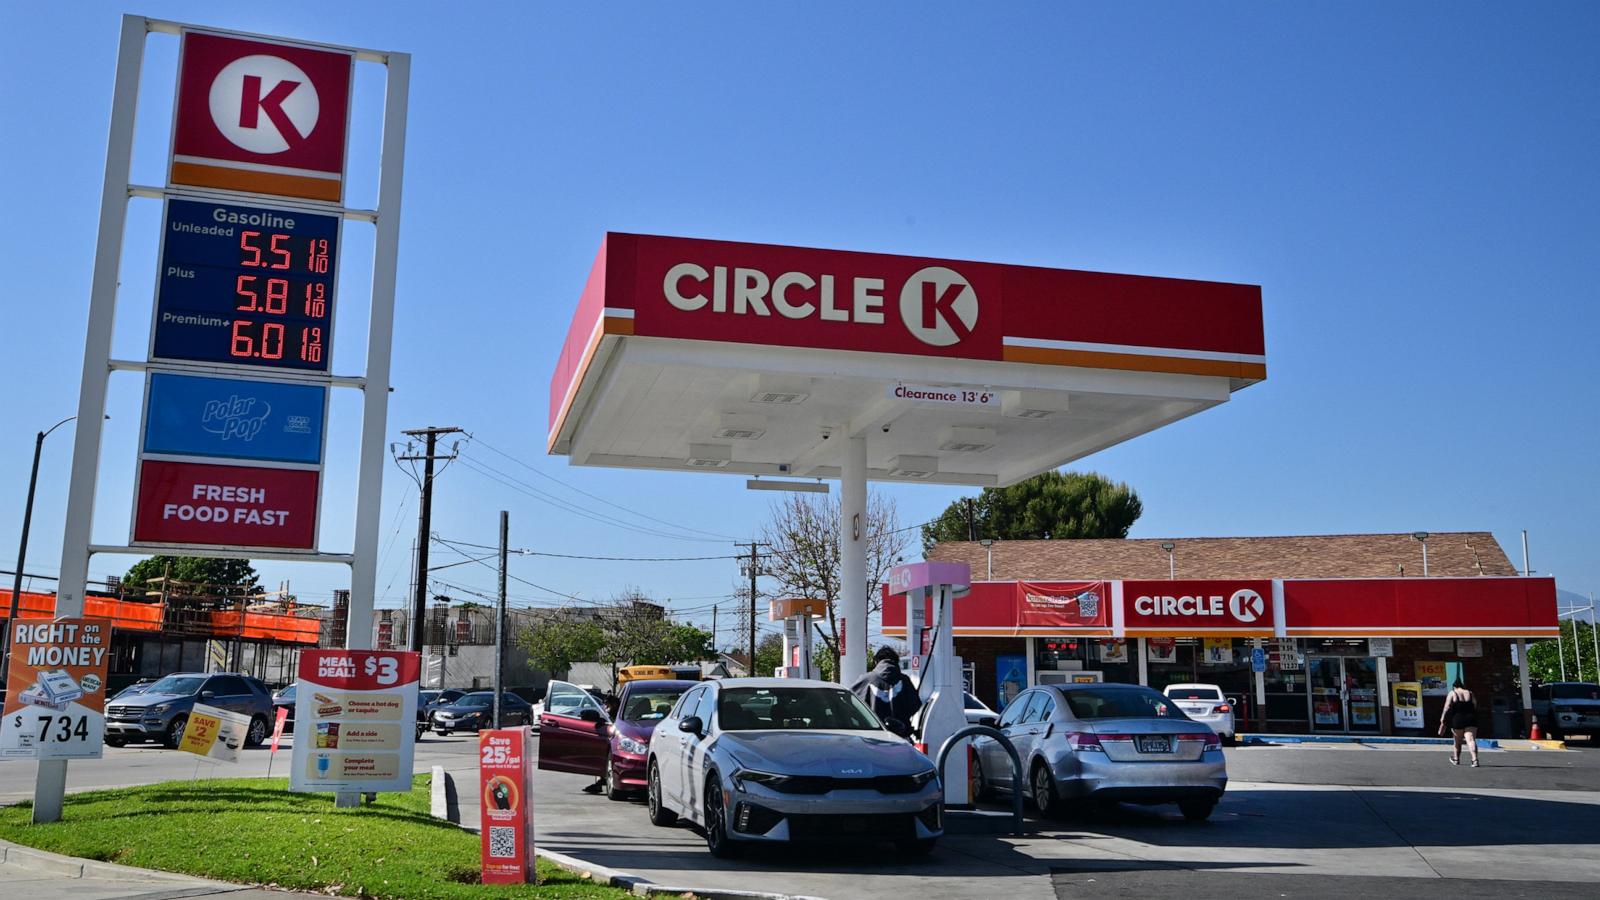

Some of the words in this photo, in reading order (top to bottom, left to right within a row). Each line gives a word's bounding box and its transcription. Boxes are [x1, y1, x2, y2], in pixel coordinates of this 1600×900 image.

[212, 208, 296, 229] Gasoline
[172, 222, 234, 237] Unleaded
[167, 267, 195, 279] Plus
[663, 262, 885, 325] CIRCLE
[163, 312, 230, 327] Premium+
[895, 387, 956, 401] Clearance
[962, 391, 978, 402] 13'
[202, 394, 256, 422] Polar
[222, 417, 263, 442] Pop
[192, 484, 265, 503] FRESH
[163, 504, 229, 523] FOOD
[233, 508, 290, 526] FAST
[1135, 595, 1224, 615] CIRCLE
[15, 624, 78, 644] RIGHT
[84, 625, 99, 633] on
[81, 634, 101, 644] the
[27, 647, 106, 666] MONEY
[318, 667, 356, 678] DEAL!
[319, 657, 356, 667] MEAL
[364, 656, 399, 685] $3
[38, 715, 88, 742] 7.34
[193, 717, 216, 728] SAVE
[489, 736, 511, 745] Save
